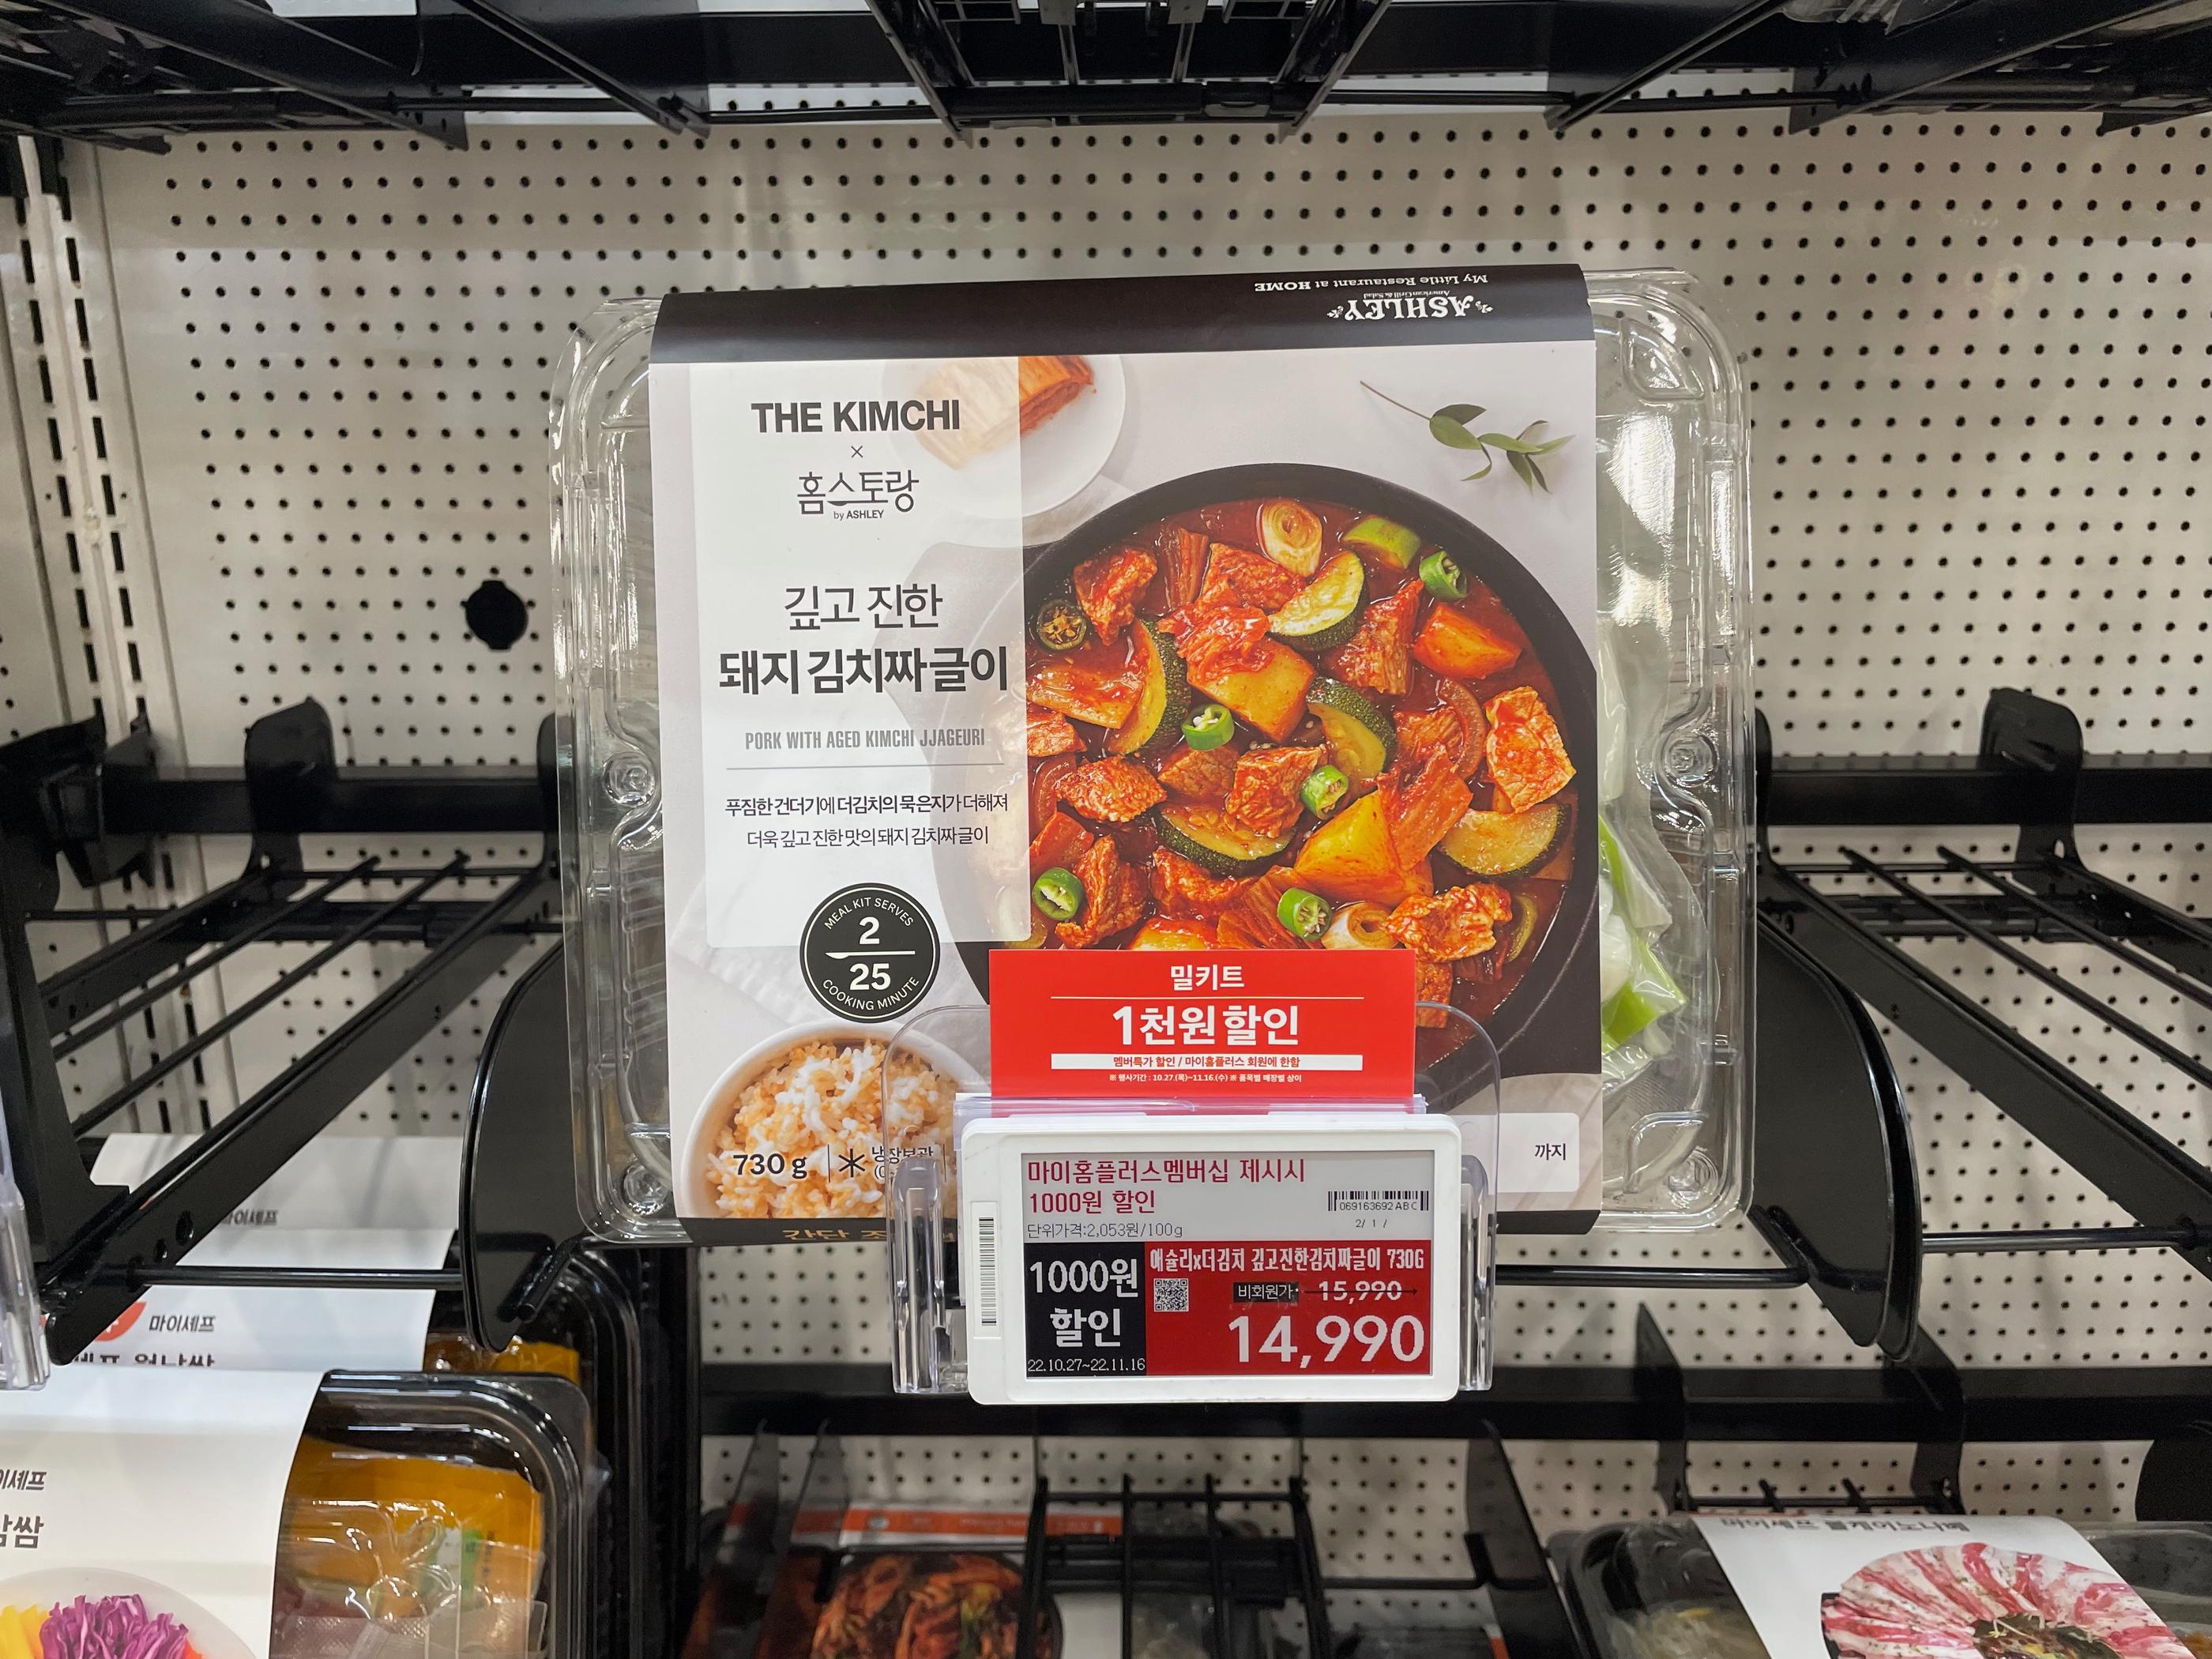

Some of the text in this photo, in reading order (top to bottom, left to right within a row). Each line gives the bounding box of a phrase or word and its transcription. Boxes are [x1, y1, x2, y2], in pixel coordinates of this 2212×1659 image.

[1255, 281, 1311, 292] HOME
[1334, 277, 1416, 288] Restaurant
[1420, 275, 1460, 284] Little
[1463, 274, 1488, 284] My
[1344, 295, 1474, 321] ASHLEY
[750, 399, 960, 433] THE KIMCHI
[797, 469, 920, 515] 홈스토랑
[833, 510, 884, 521] by ASHLEY
[784, 583, 943, 630] 깊고 진한
[719, 645, 1007, 695] 돼지 김치짜글이
[745, 728, 985, 750] PORK WITH AGED KIMCHI JJAGEURI
[724, 793, 1008, 817] 푸짐한 건더기에 더김치의 묵은지가 더해져
[747, 826, 989, 848] 더욱 깊고 진한 맛의 돼지 김치짜글이
[824, 897, 914, 930] MEAL KIT SERVES
[859, 916, 880, 945] 2
[849, 962, 891, 991] 25
[1170, 964, 1245, 991] 밀키트
[822, 976, 920, 1010] COOKING MINUTE
[1112, 1004, 1300, 1047] 1천원 할인
[1113, 1056, 1153, 1067] 멤버특가
[1156, 1056, 1176, 1067] 할인
[1185, 1055, 1245, 1067] 마이홈플러스
[1247, 1056, 1277, 1067] 회원에
[1280, 1056, 1300, 1068] 한함
[1534, 1142, 1567, 1161] 까지
[732, 1153, 807, 1179] 730 g
[1028, 1158, 1306, 1184] 마이홈플러스멤버십 제시시
[1029, 1190, 1155, 1214] 1000원 할인
[1386, 1248, 1424, 1269] 730G
[1029, 1258, 1138, 1298] 1000원
[1238, 1280, 1403, 1305] 비회원가 15,990
[1050, 1307, 1121, 1347] 할인
[1228, 1315, 1424, 1369] 14,990
